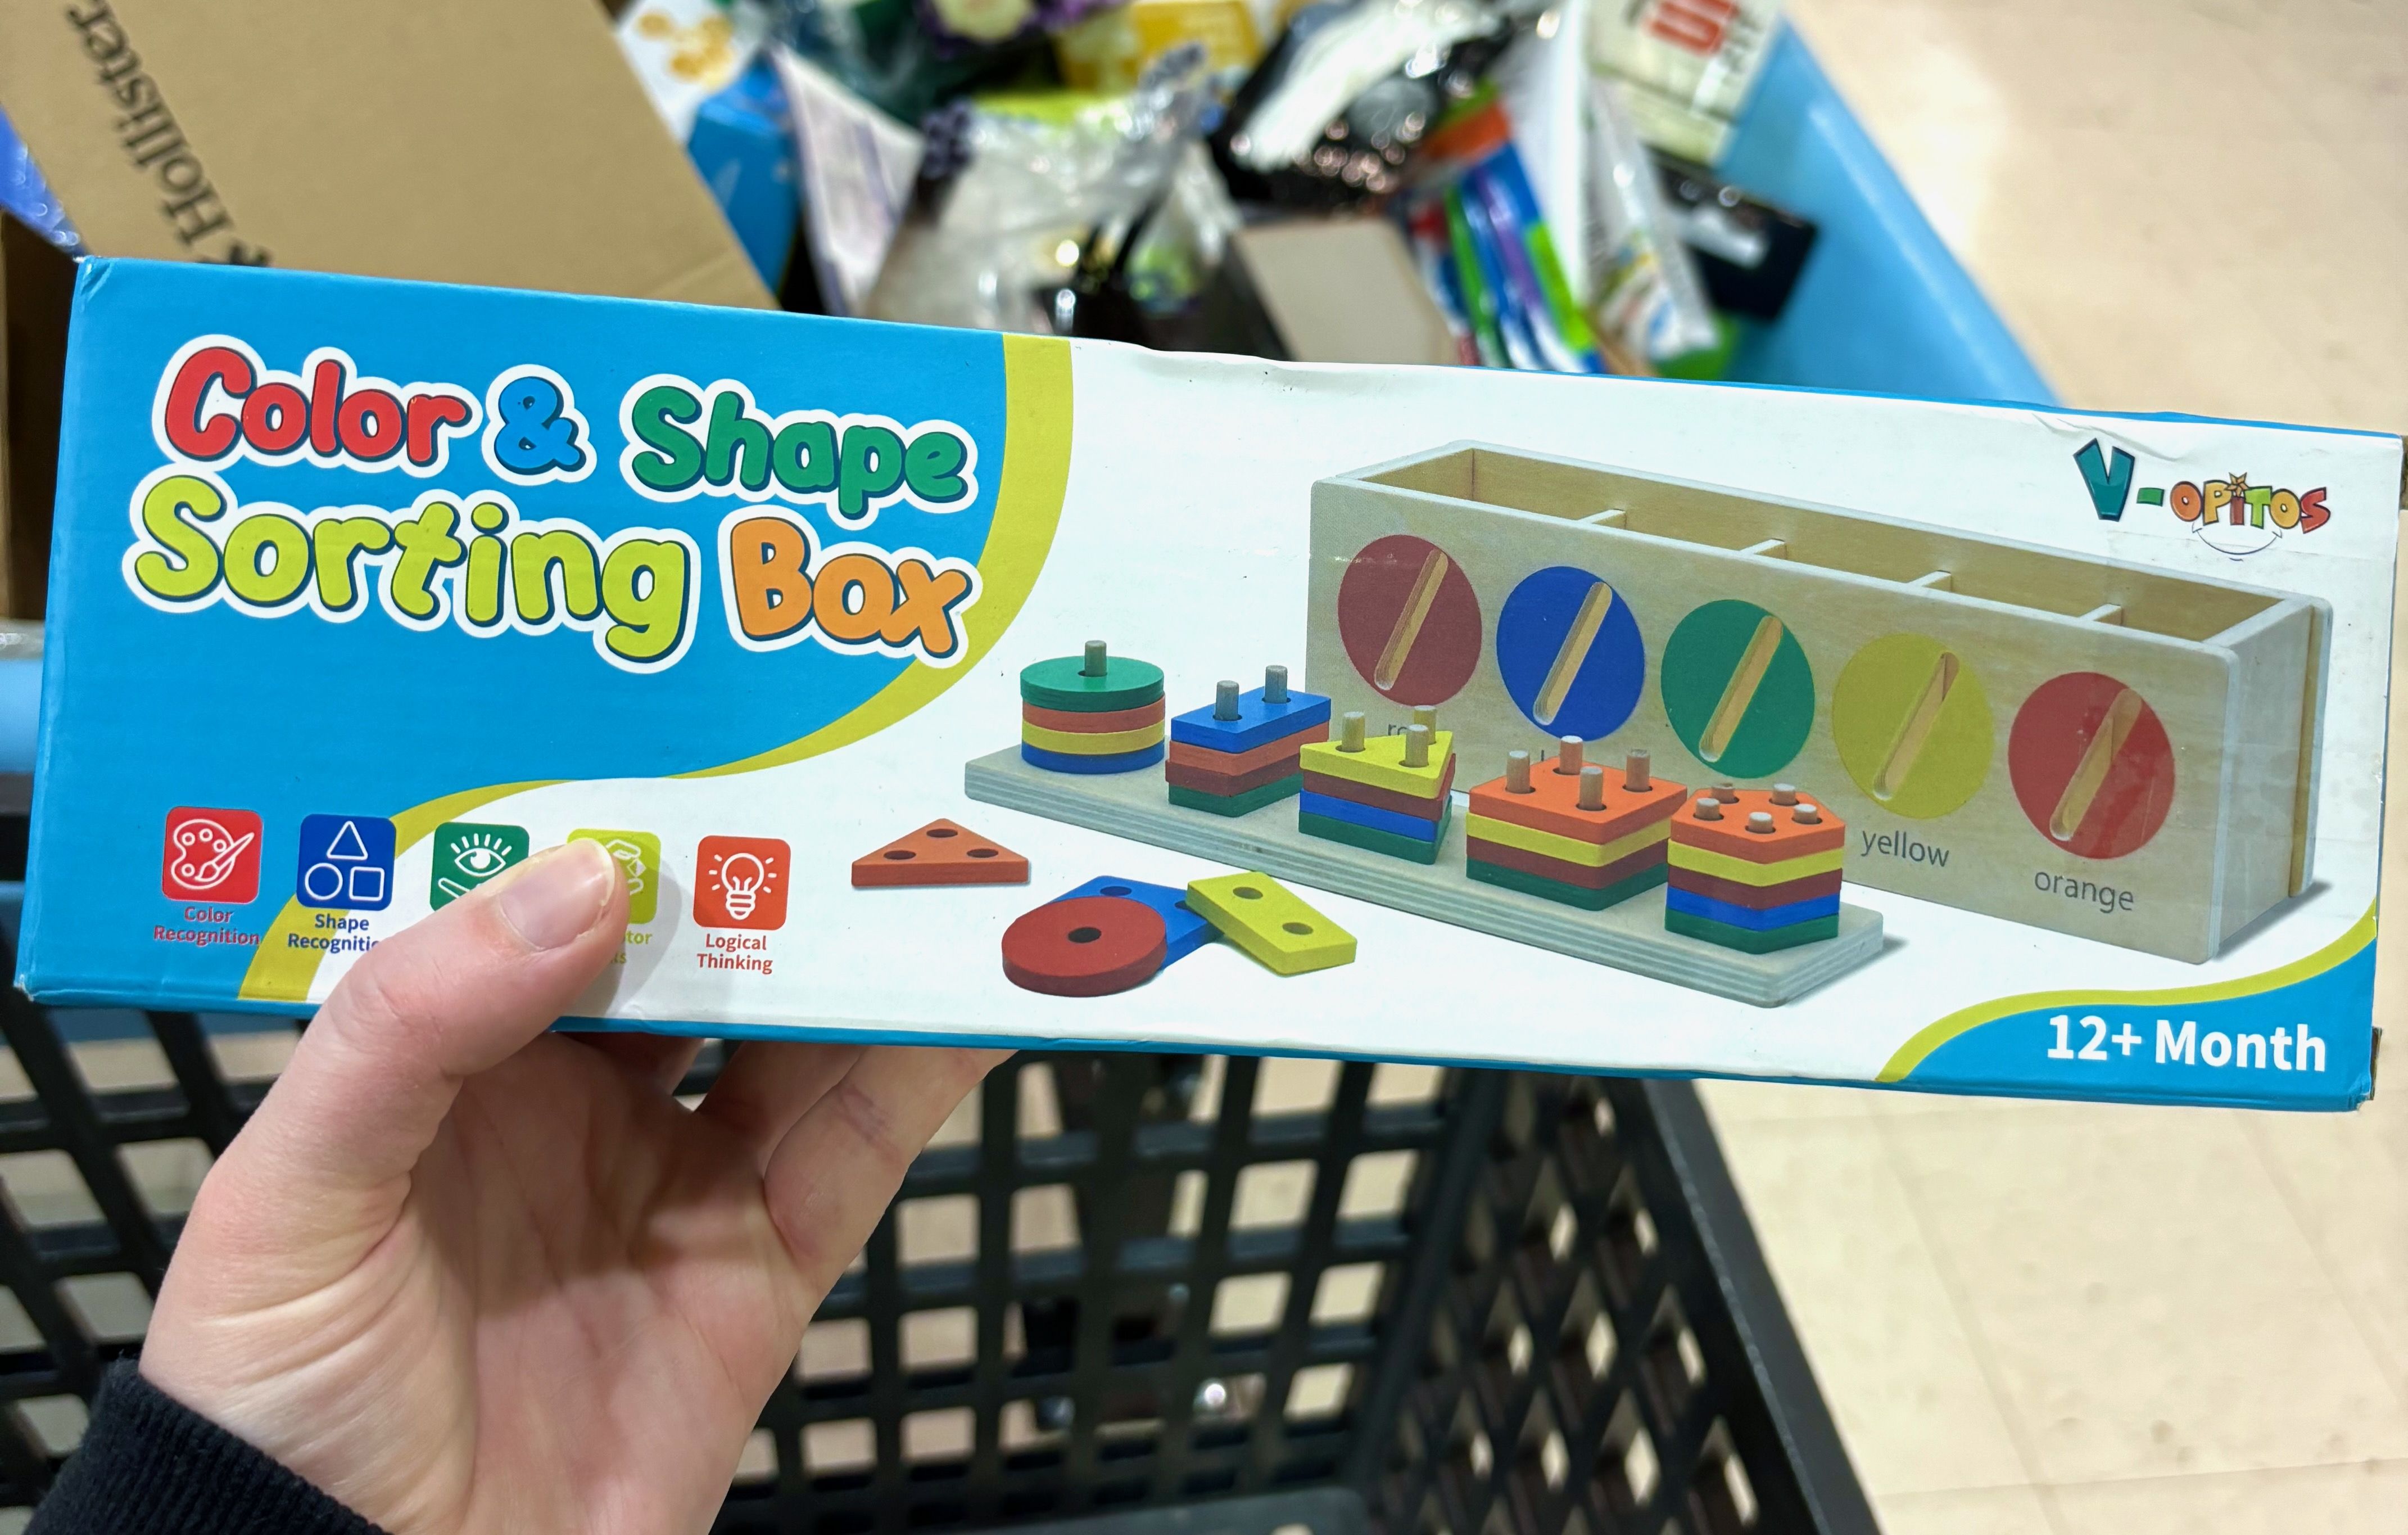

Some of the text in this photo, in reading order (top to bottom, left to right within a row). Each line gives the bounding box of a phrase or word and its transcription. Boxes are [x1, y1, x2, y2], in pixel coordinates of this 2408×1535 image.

[66, 0, 236, 246] Hollister
[164, 345, 970, 521] Color & Shape
[134, 473, 974, 663] Sorting Box
[1861, 830, 1950, 868] yellow
[2034, 871, 2134, 914] orange
[184, 906, 234, 924] Color
[314, 913, 370, 933] Shape
[153, 924, 260, 947] Recognition
[705, 933, 767, 952] Logical
[696, 952, 773, 975] Thinking
[2047, 1014, 2326, 1072] 12+ Month
